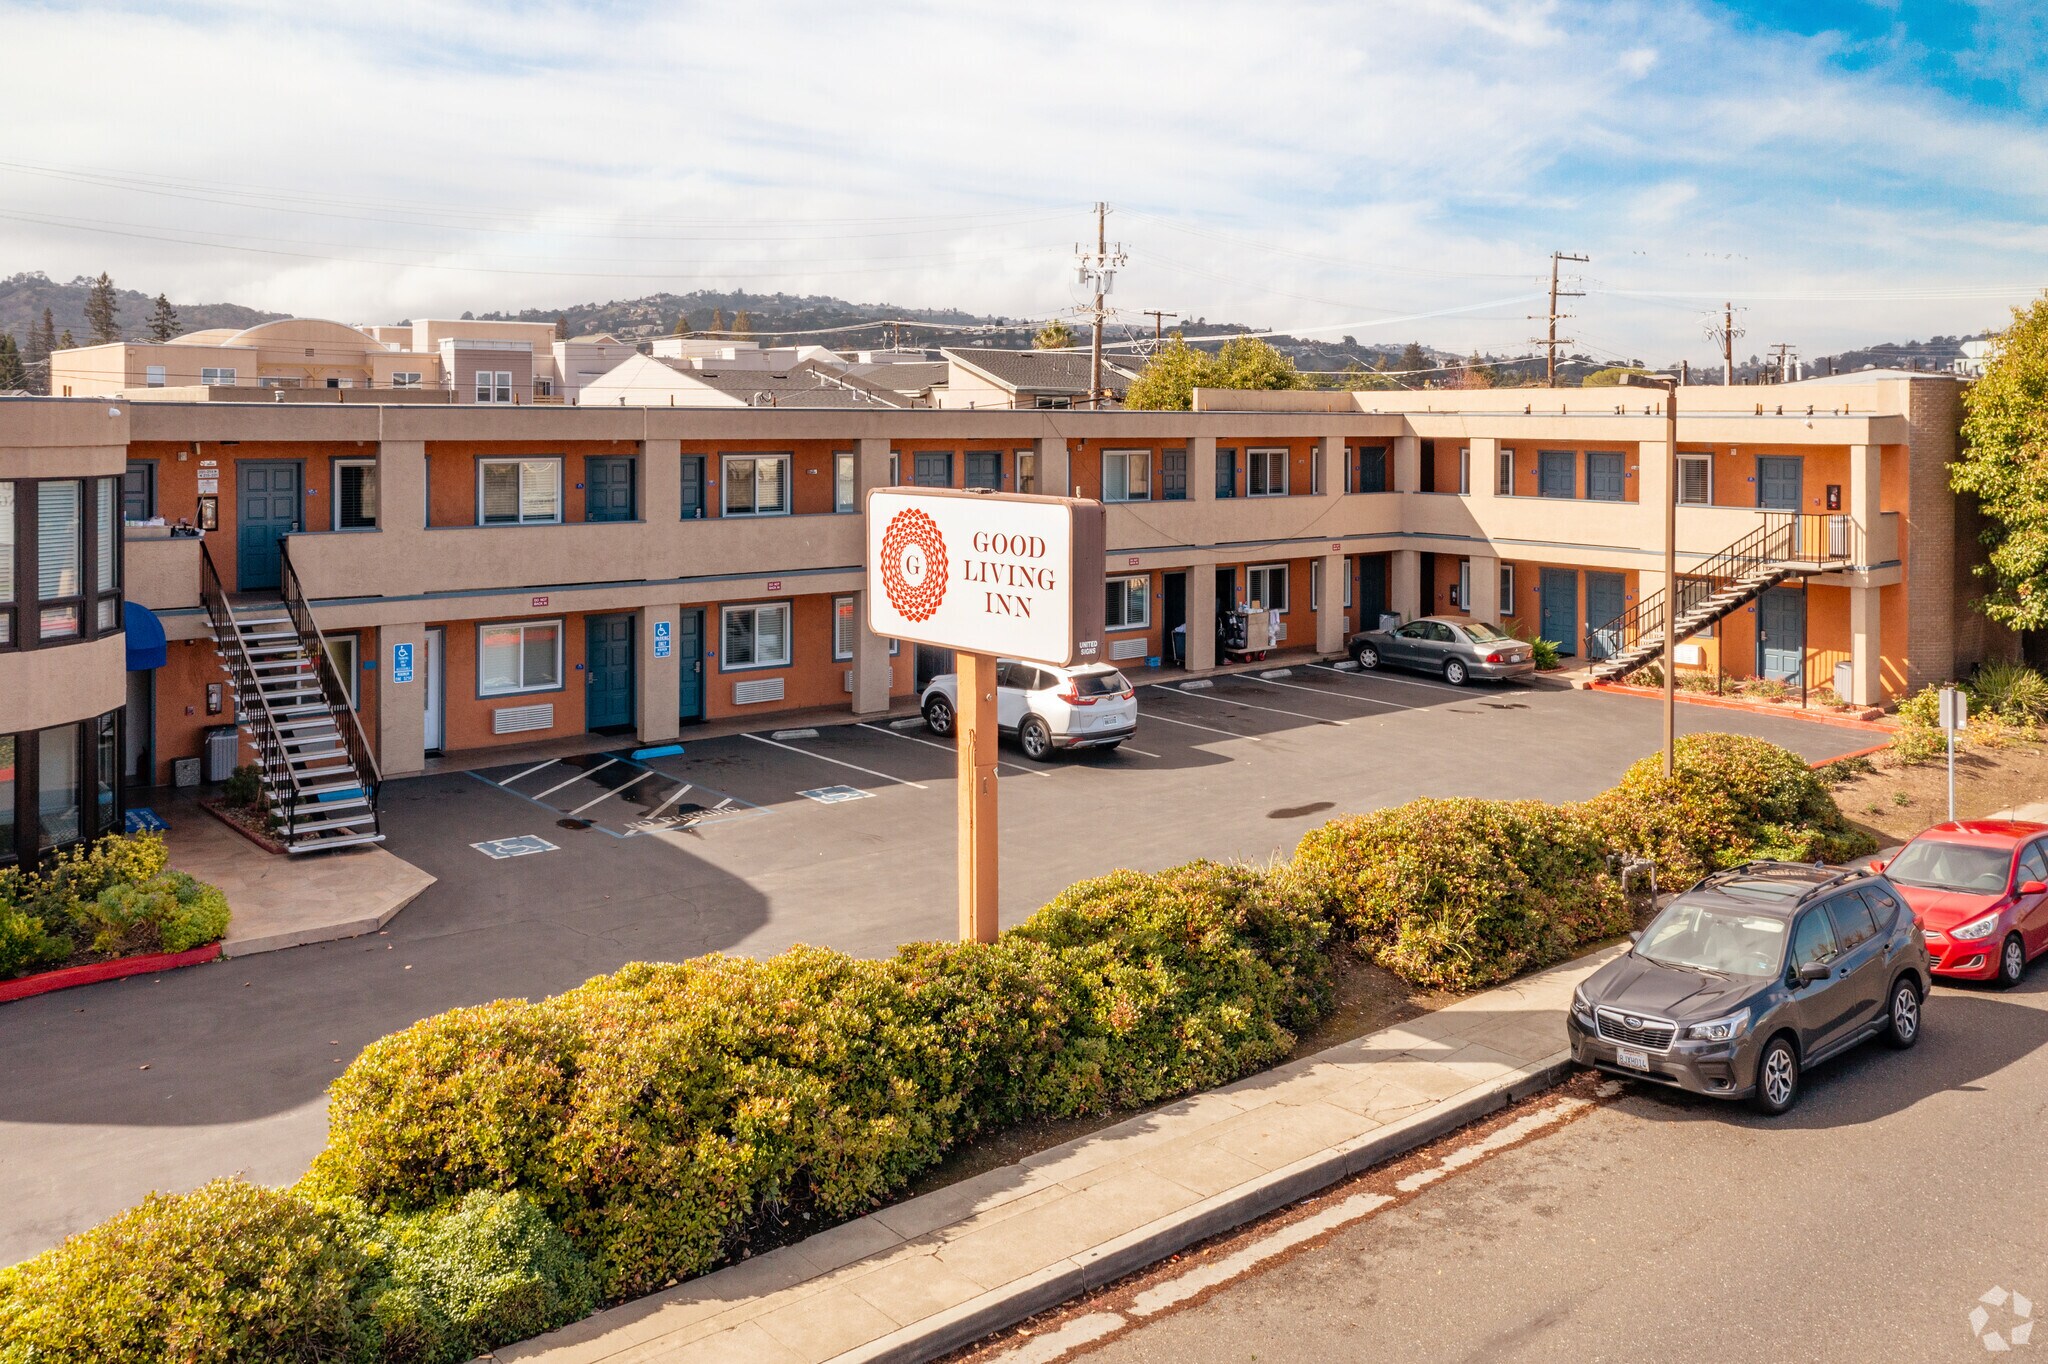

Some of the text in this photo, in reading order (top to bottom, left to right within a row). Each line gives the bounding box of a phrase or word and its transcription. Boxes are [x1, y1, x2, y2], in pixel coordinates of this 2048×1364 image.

[973, 531, 1046, 558] GOOD
[906, 555, 920, 575] G
[963, 560, 1056, 591] LIVING
[985, 592, 1032, 619] INN
[1079, 640, 1097, 648] UNITED
[1080, 647, 1096, 655] SIGNS
[624, 806, 741, 830] NO PARKING
